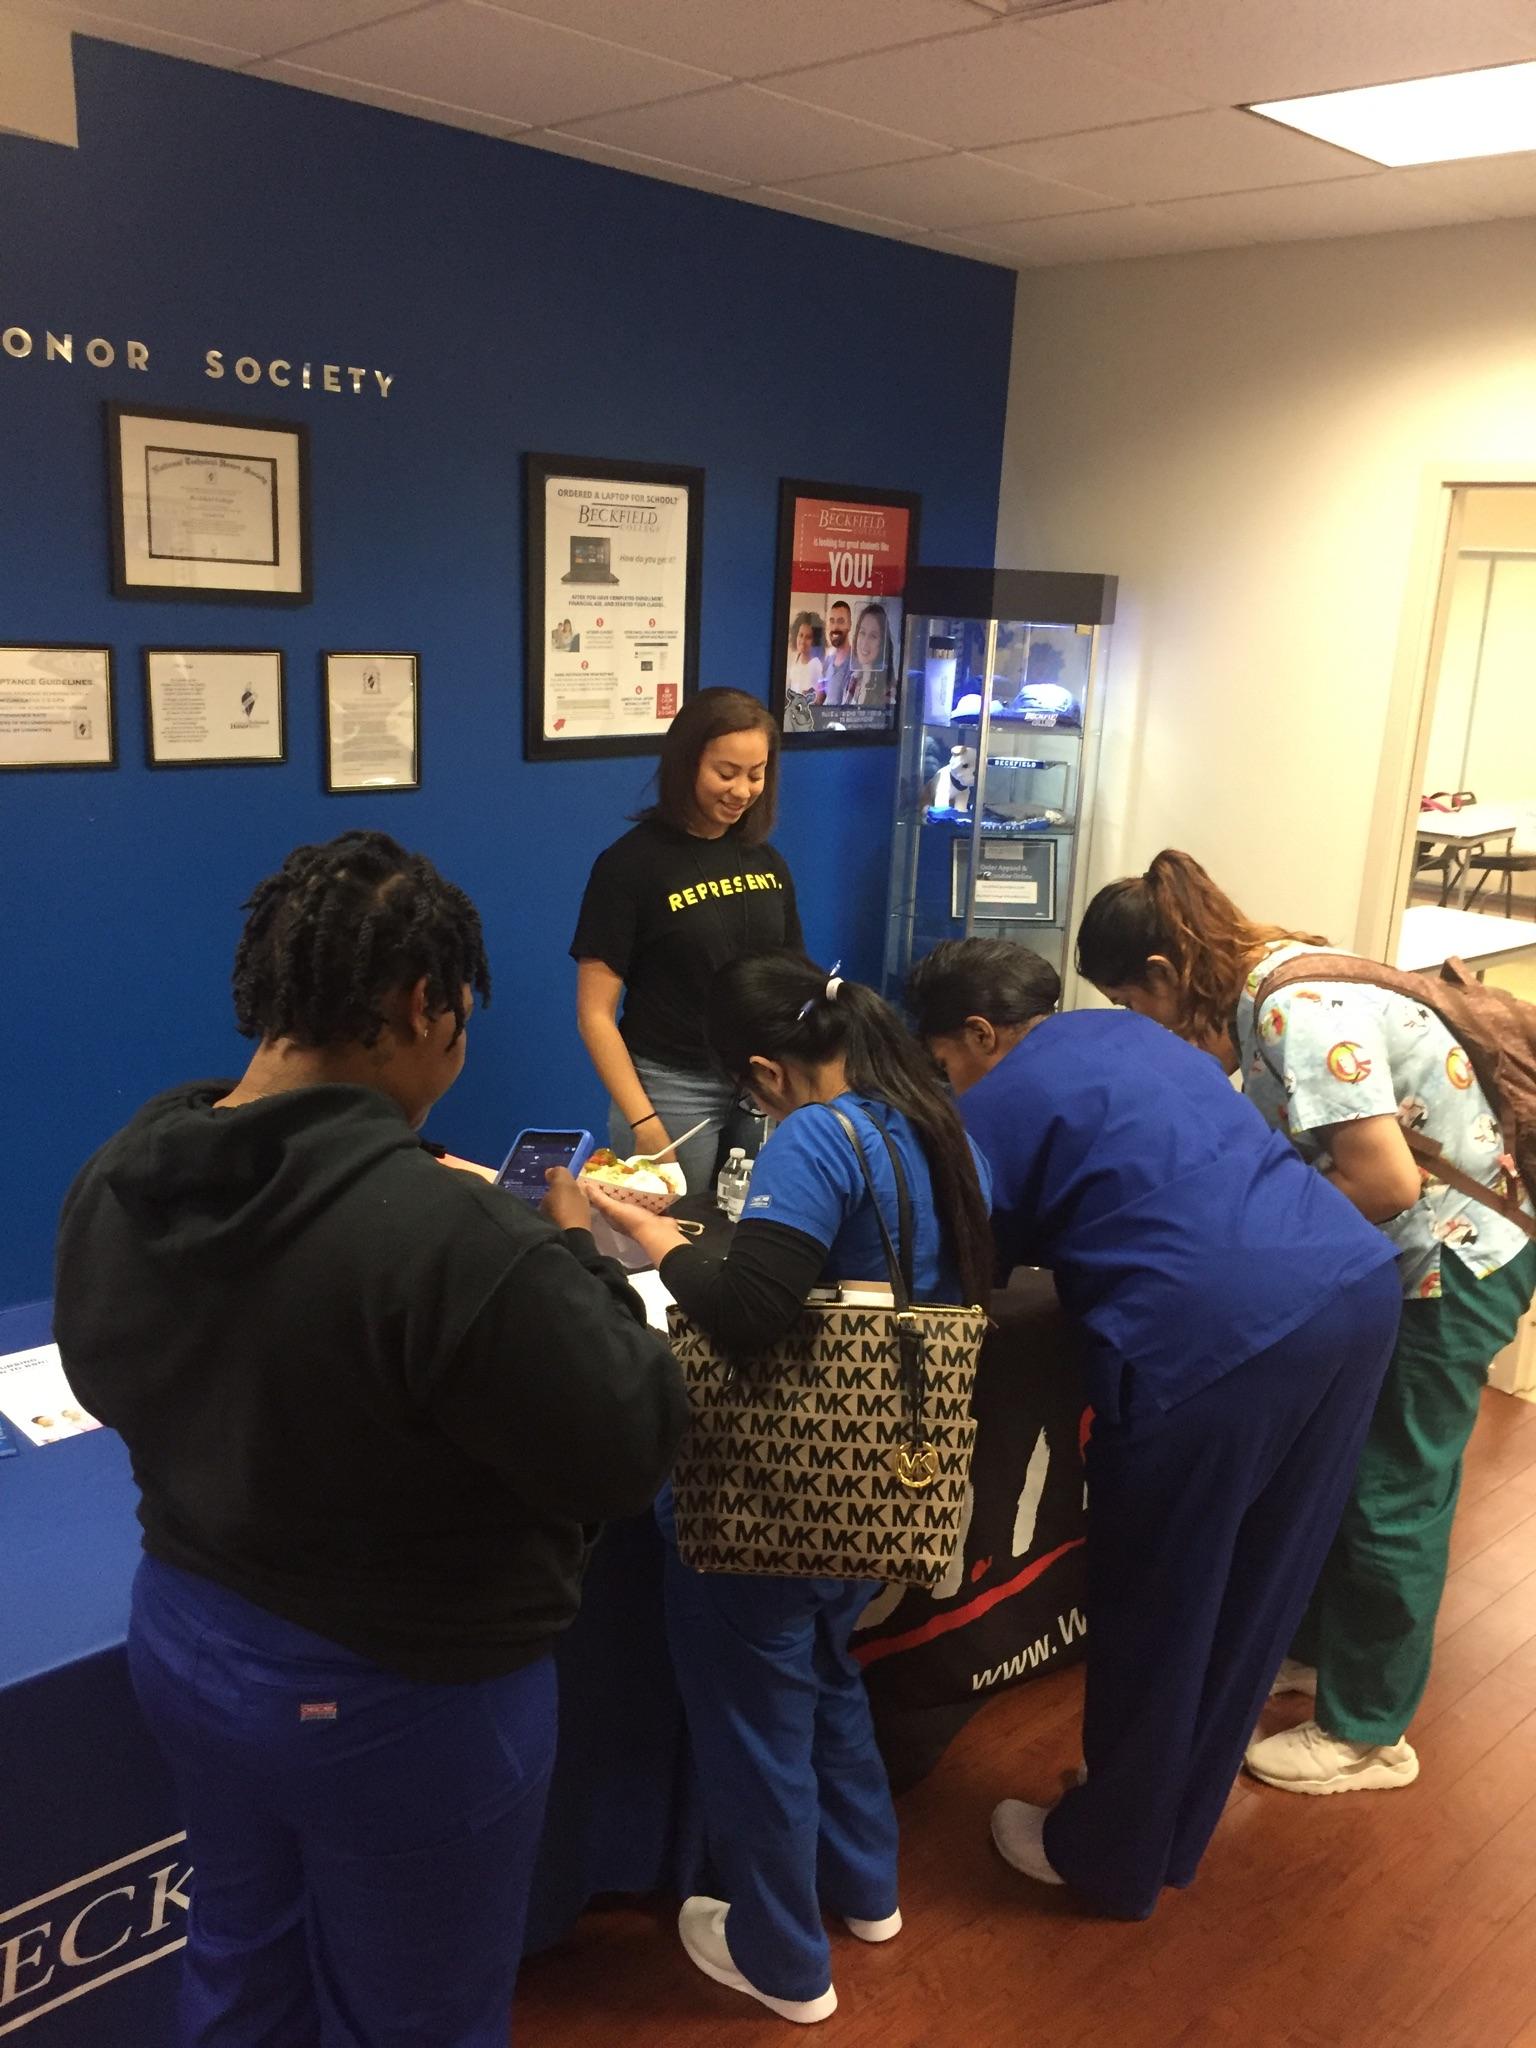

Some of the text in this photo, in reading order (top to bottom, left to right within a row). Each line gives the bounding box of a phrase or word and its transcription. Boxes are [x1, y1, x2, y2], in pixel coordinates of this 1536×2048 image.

[2, 326, 395, 398] ONOR SOCIETY
[558, 489, 592, 499] ORDERED
[631, 494, 644, 502] FOR
[646, 495, 678, 504] SCHOOL?
[579, 505, 658, 525] BECKFIELD
[819, 509, 885, 529] BECKFIELD
[829, 552, 873, 588] YOU!
[841, 1314, 879, 1336] MK
[924, 1320, 958, 1342] MK
[821, 1340, 856, 1362] MK
[862, 1341, 899, 1363] MK
[942, 1345, 974, 1368] MK
[687, 1361, 721, 1382] MK
[799, 1366, 832, 1387] MK
[837, 1367, 875, 1389] MK
[775, 1389, 812, 1413] MK
[815, 1393, 852, 1416] MK
[857, 1395, 896, 1416] MK
[935, 1398, 966, 1420] MK
[713, 1412, 746, 1434] MK
[751, 1413, 787, 1437] MK
[791, 1417, 827, 1441] MK
[832, 1420, 872, 1442] MK
[728, 1438, 764, 1463] MK
[767, 1442, 805, 1466] MK
[809, 1446, 847, 1470] MK
[853, 1448, 891, 1471] MK
[744, 1466, 780, 1491] MK
[784, 1471, 821, 1496] MK
[827, 1475, 866, 1498] MK
[872, 1477, 911, 1499] MK
[719, 1492, 756, 1516] MK
[762, 1496, 799, 1521] MK
[803, 1500, 842, 1524] MK
[848, 1503, 887, 1527] MK
[925, 1505, 956, 1529] MK
[736, 1521, 774, 1546] MK
[779, 1525, 818, 1550] MK
[823, 1528, 862, 1553] MK
[867, 1532, 906, 1554] MK
[711, 1545, 748, 1566] MK
[754, 1549, 792, 1569] MK
[798, 1553, 836, 1572] MK
[842, 1557, 880, 1573] MK
[918, 1560, 950, 1582] MK
[0, 1862, 194, 2007] ECK
